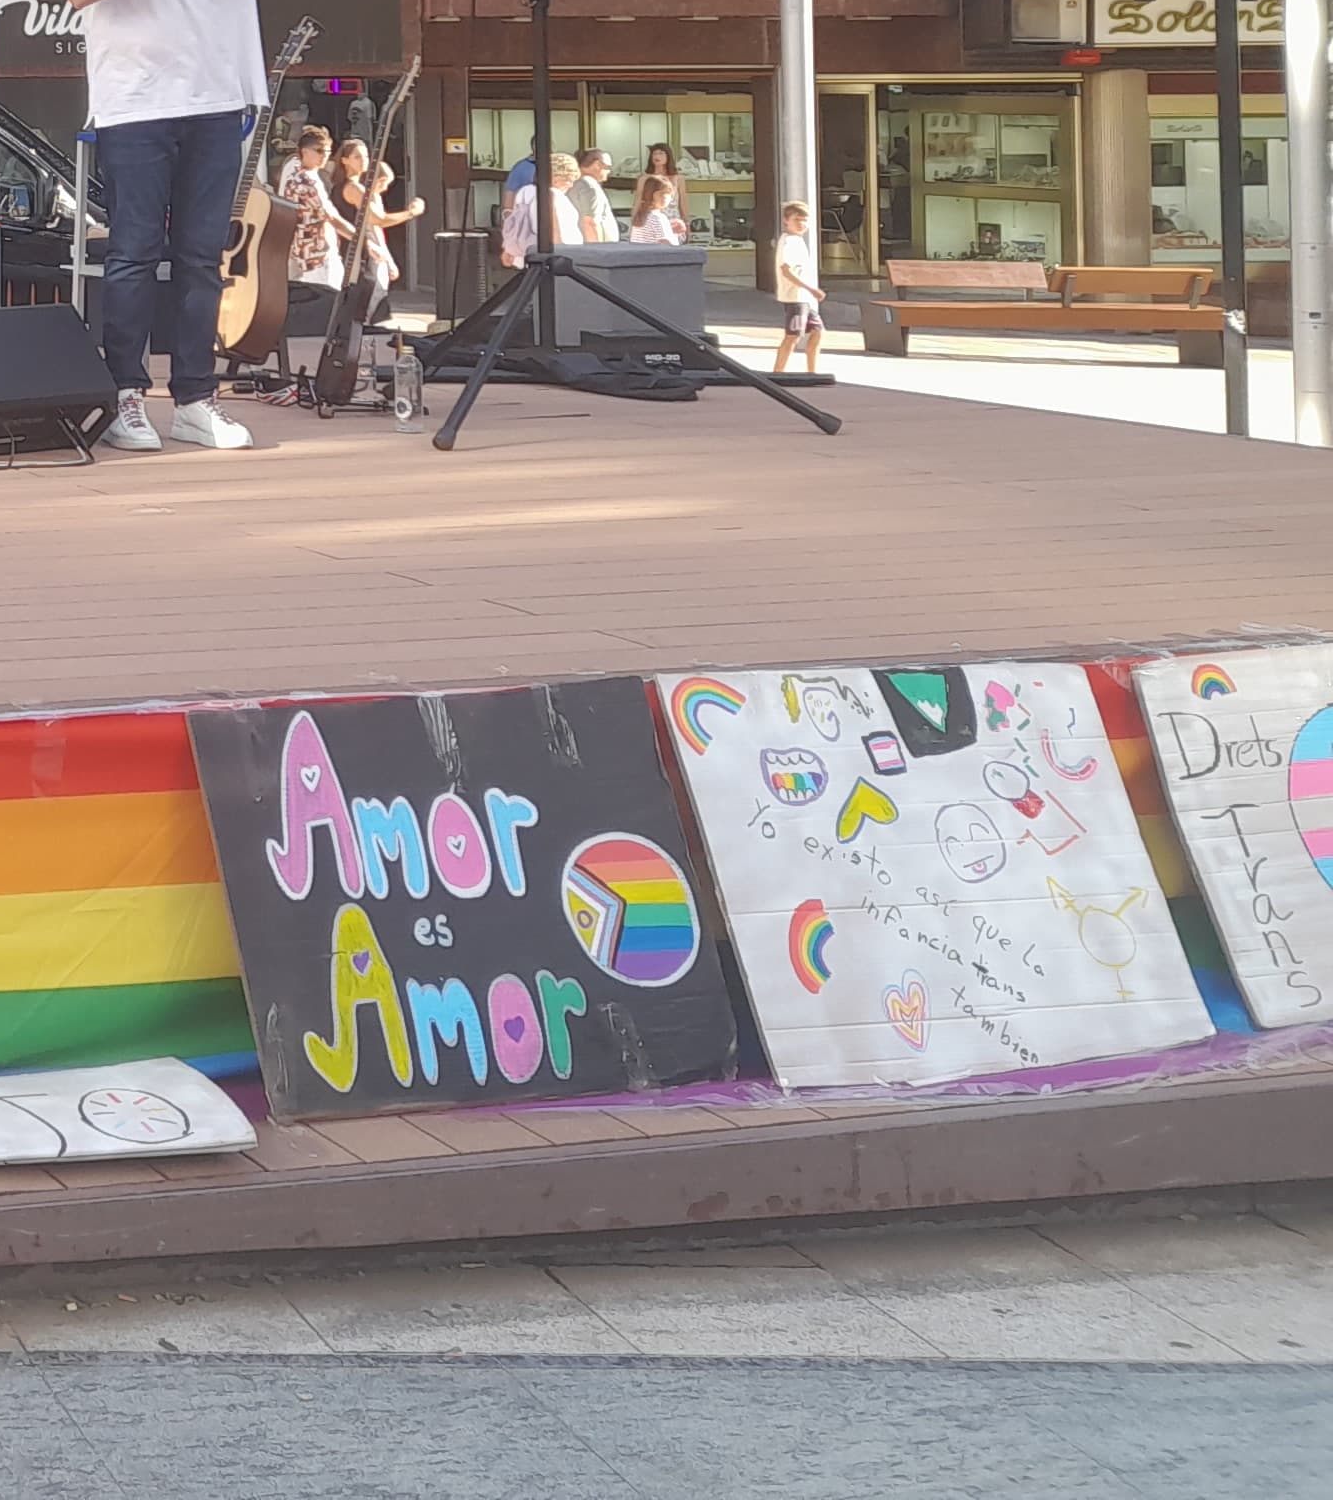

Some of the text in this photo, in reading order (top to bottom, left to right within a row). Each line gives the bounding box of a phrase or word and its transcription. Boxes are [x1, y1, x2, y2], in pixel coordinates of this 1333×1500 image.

[265, 710, 538, 900] Amor
[1157, 711, 1282, 780] Drets
[414, 913, 454, 947] es
[973, 915, 1012, 951] que
[1200, 803, 1322, 1008] Trans
[303, 902, 587, 1093] Amor
